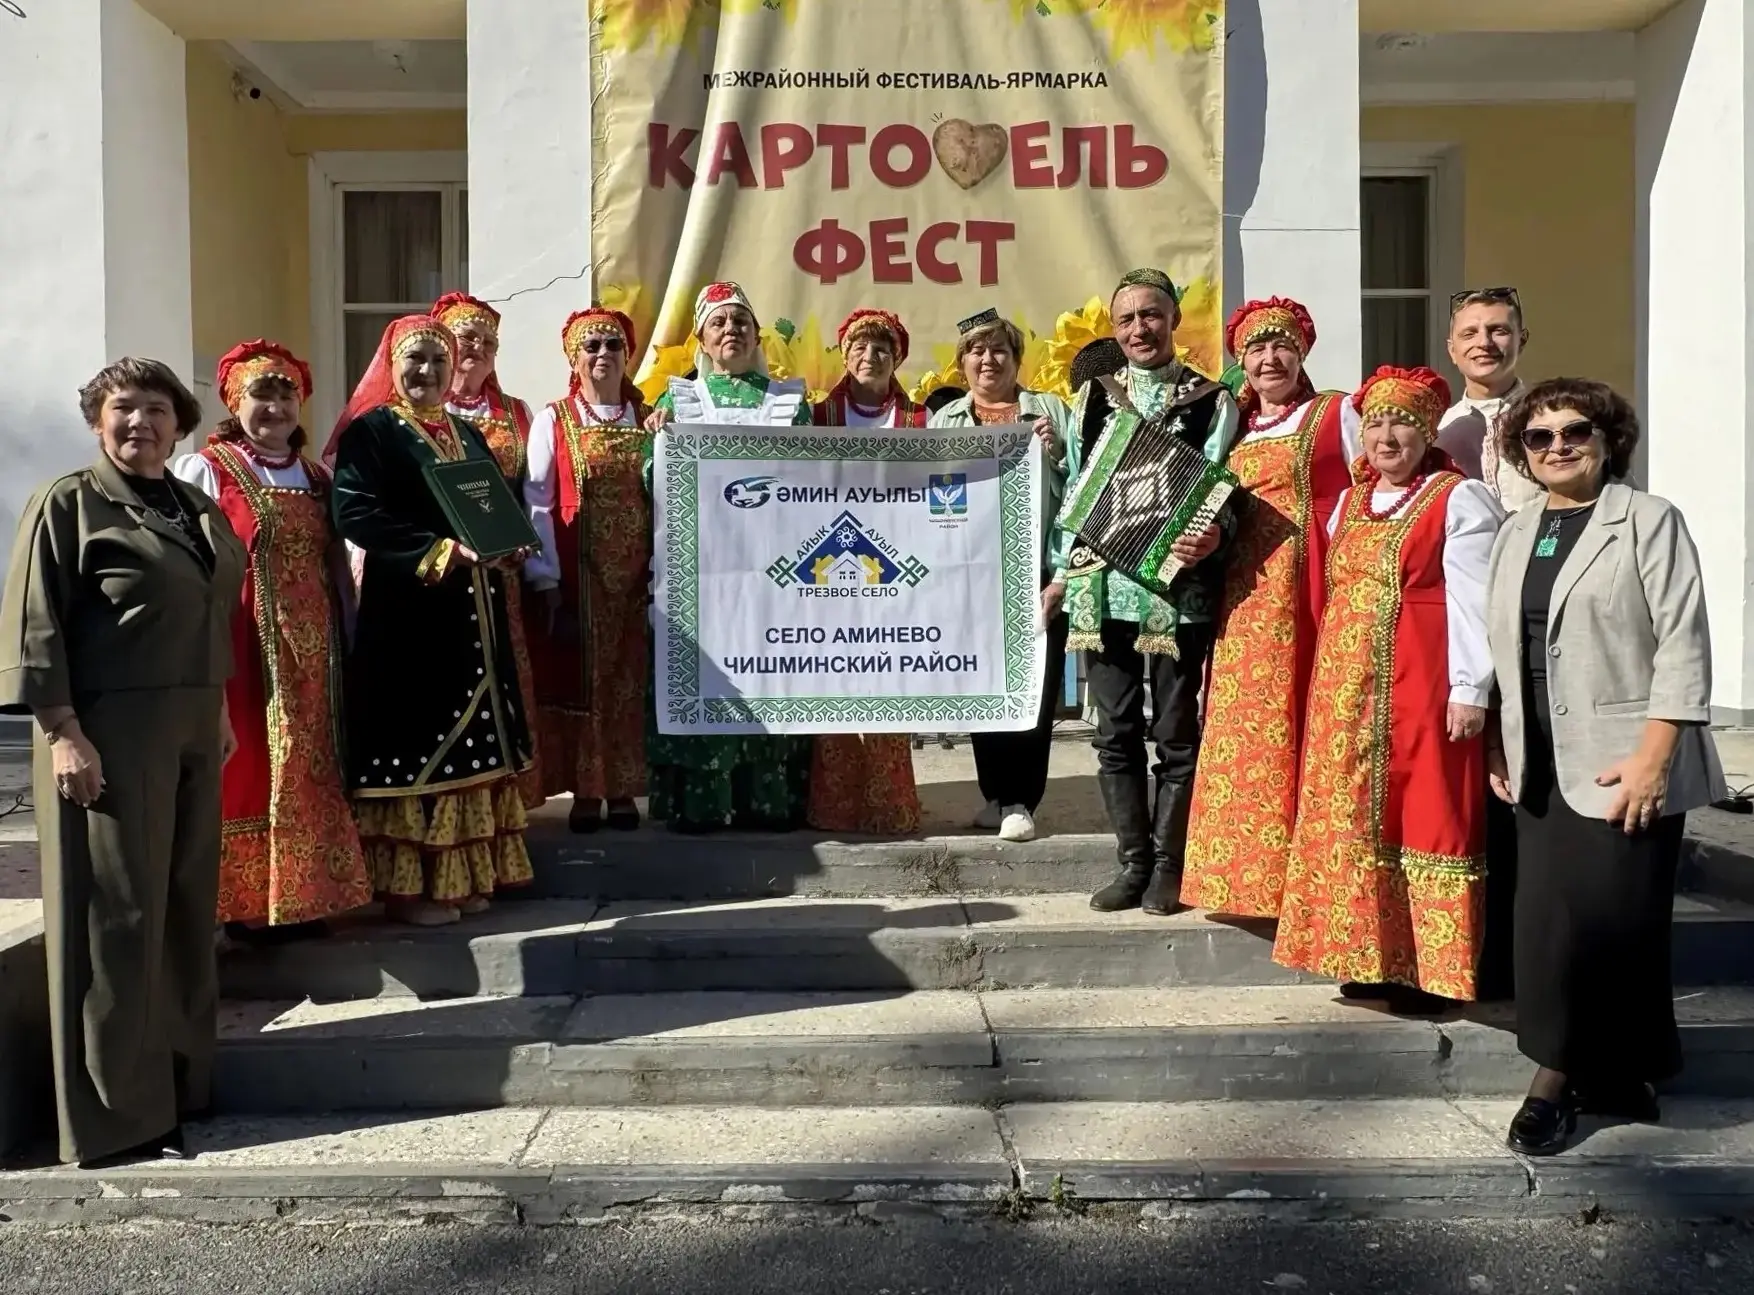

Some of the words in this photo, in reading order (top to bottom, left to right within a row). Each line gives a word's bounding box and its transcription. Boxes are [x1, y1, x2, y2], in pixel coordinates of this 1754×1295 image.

[703, 68, 870, 90] МЕЖРАЙОННЫЙ
[876, 71, 1108, 90] ФЕСТИВАЛЬ-ЯРМАРКА
[647, 117, 1169, 191] КАРТОЕЛЬ
[793, 218, 1016, 287] ФЕСТ
[776, 486, 838, 502] ӘМИН
[844, 486, 926, 502] АУЫЛЫ
[865, 528, 899, 559] АУЫЛ
[797, 587, 858, 598] ТРЕЗВОЕ
[861, 587, 899, 598] СЕЛО
[765, 627, 826, 644] СЕЛО
[832, 626, 942, 644] АМИНЕВО
[723, 651, 892, 674] ЧИШМИНСКИЙ
[899, 650, 978, 673] РАЙОН
